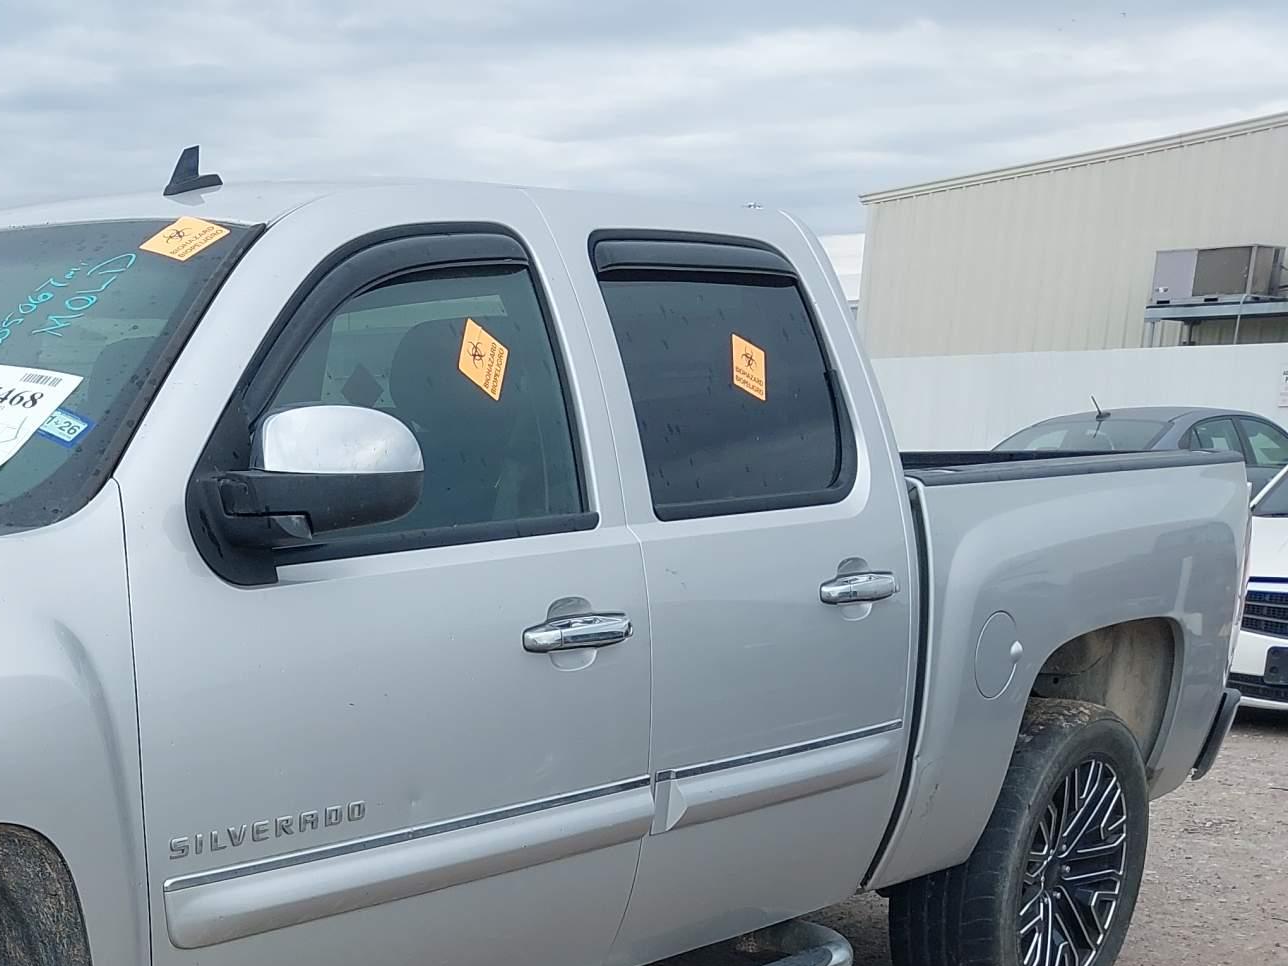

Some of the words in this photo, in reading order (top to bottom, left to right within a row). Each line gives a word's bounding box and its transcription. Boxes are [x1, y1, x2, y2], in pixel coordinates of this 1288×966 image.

[31, 253, 137, 337] MOLD
[483, 342, 497, 389] BIOHAZARD
[490, 348, 504, 395] BIOPELIGRO
[58, 420, 81, 435] 26
[169, 800, 366, 860] SILVERADO
